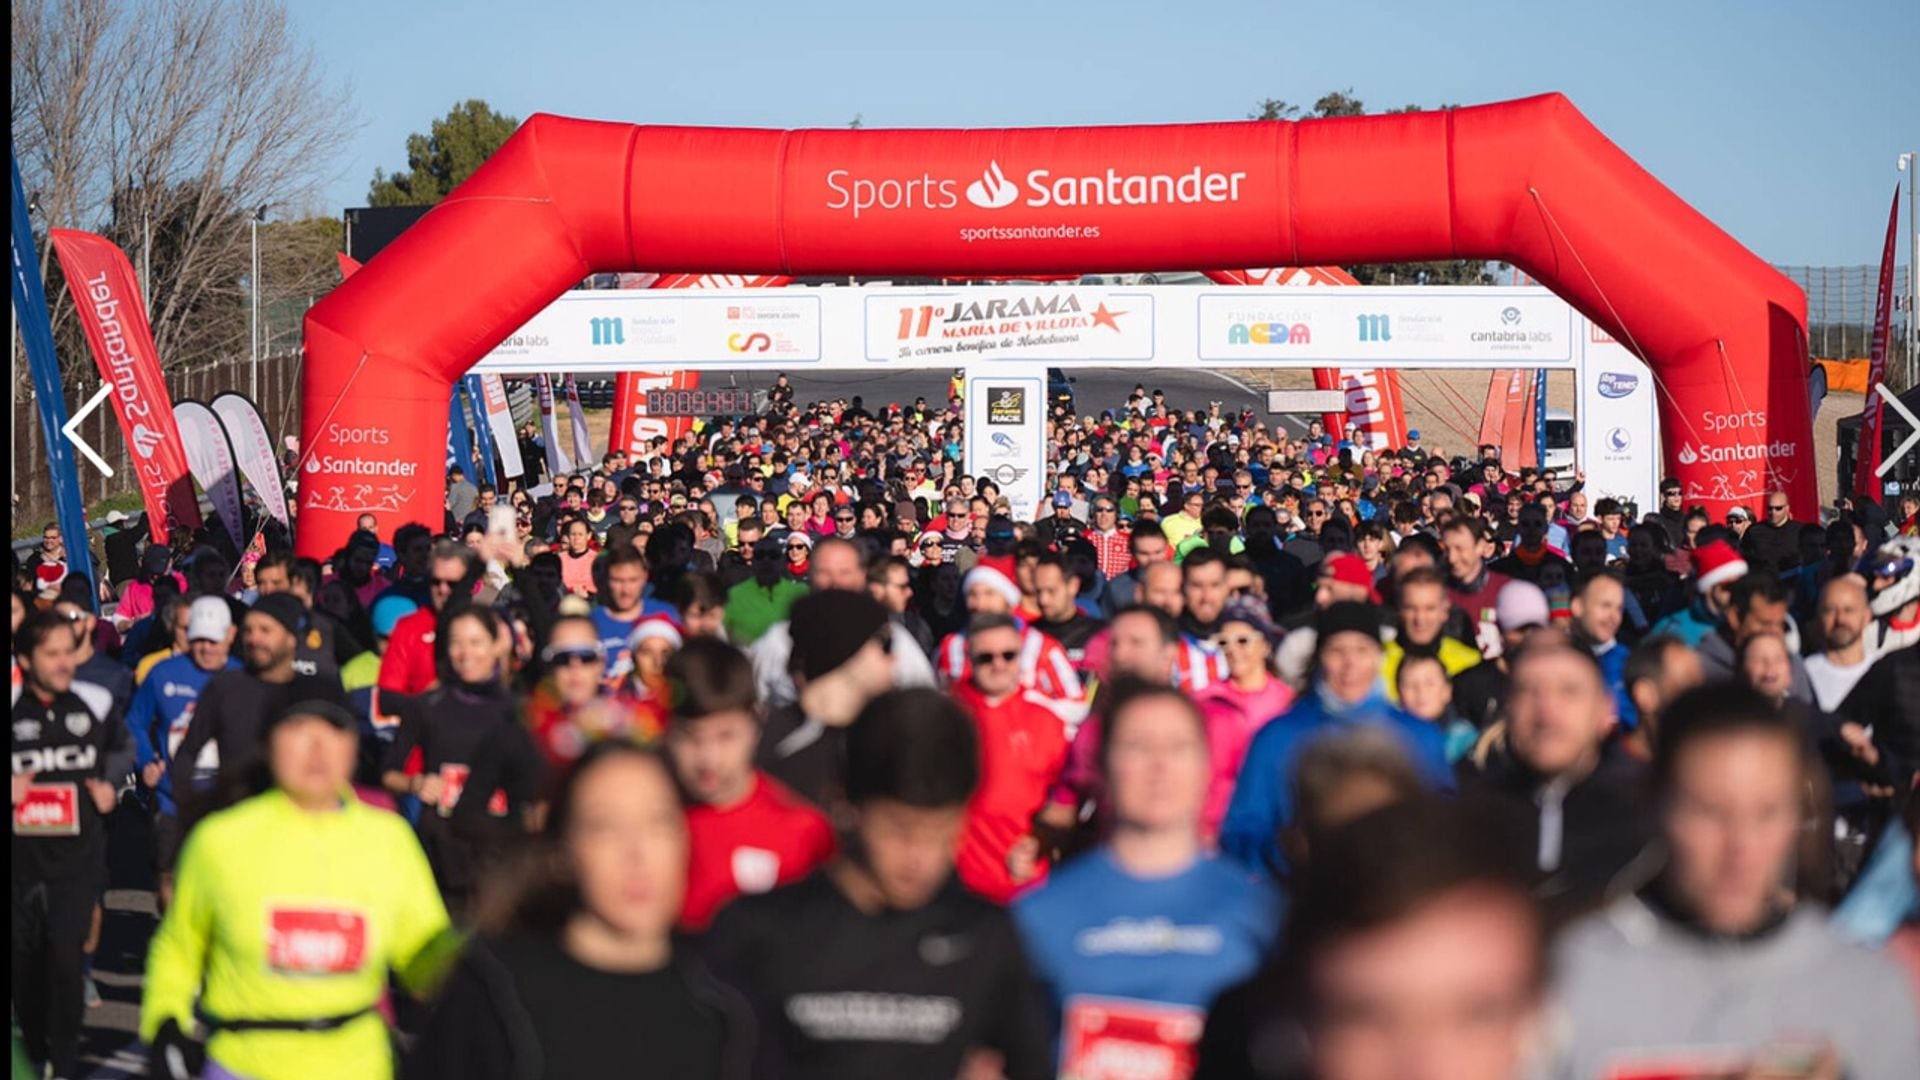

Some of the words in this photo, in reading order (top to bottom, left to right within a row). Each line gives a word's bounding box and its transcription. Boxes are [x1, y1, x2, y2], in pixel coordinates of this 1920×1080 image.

[827, 170, 957, 218] Sports
[1027, 166, 1246, 207] Santander
[960, 225, 1100, 242] sportssantander.es
[943, 293, 1082, 323] JARAMA
[999, 321, 1022, 334] DE
[1025, 316, 1089, 331] VILLOTA
[1001, 337, 1014, 348] de
[1016, 333, 1081, 348] Nochebuena
[1470, 330, 1527, 343] cantabria
[1528, 330, 1553, 343] labs
[1703, 410, 1766, 434] Sports
[329, 423, 389, 446] Sports
[1701, 440, 1796, 463] Santander
[322, 455, 418, 476] Santander
